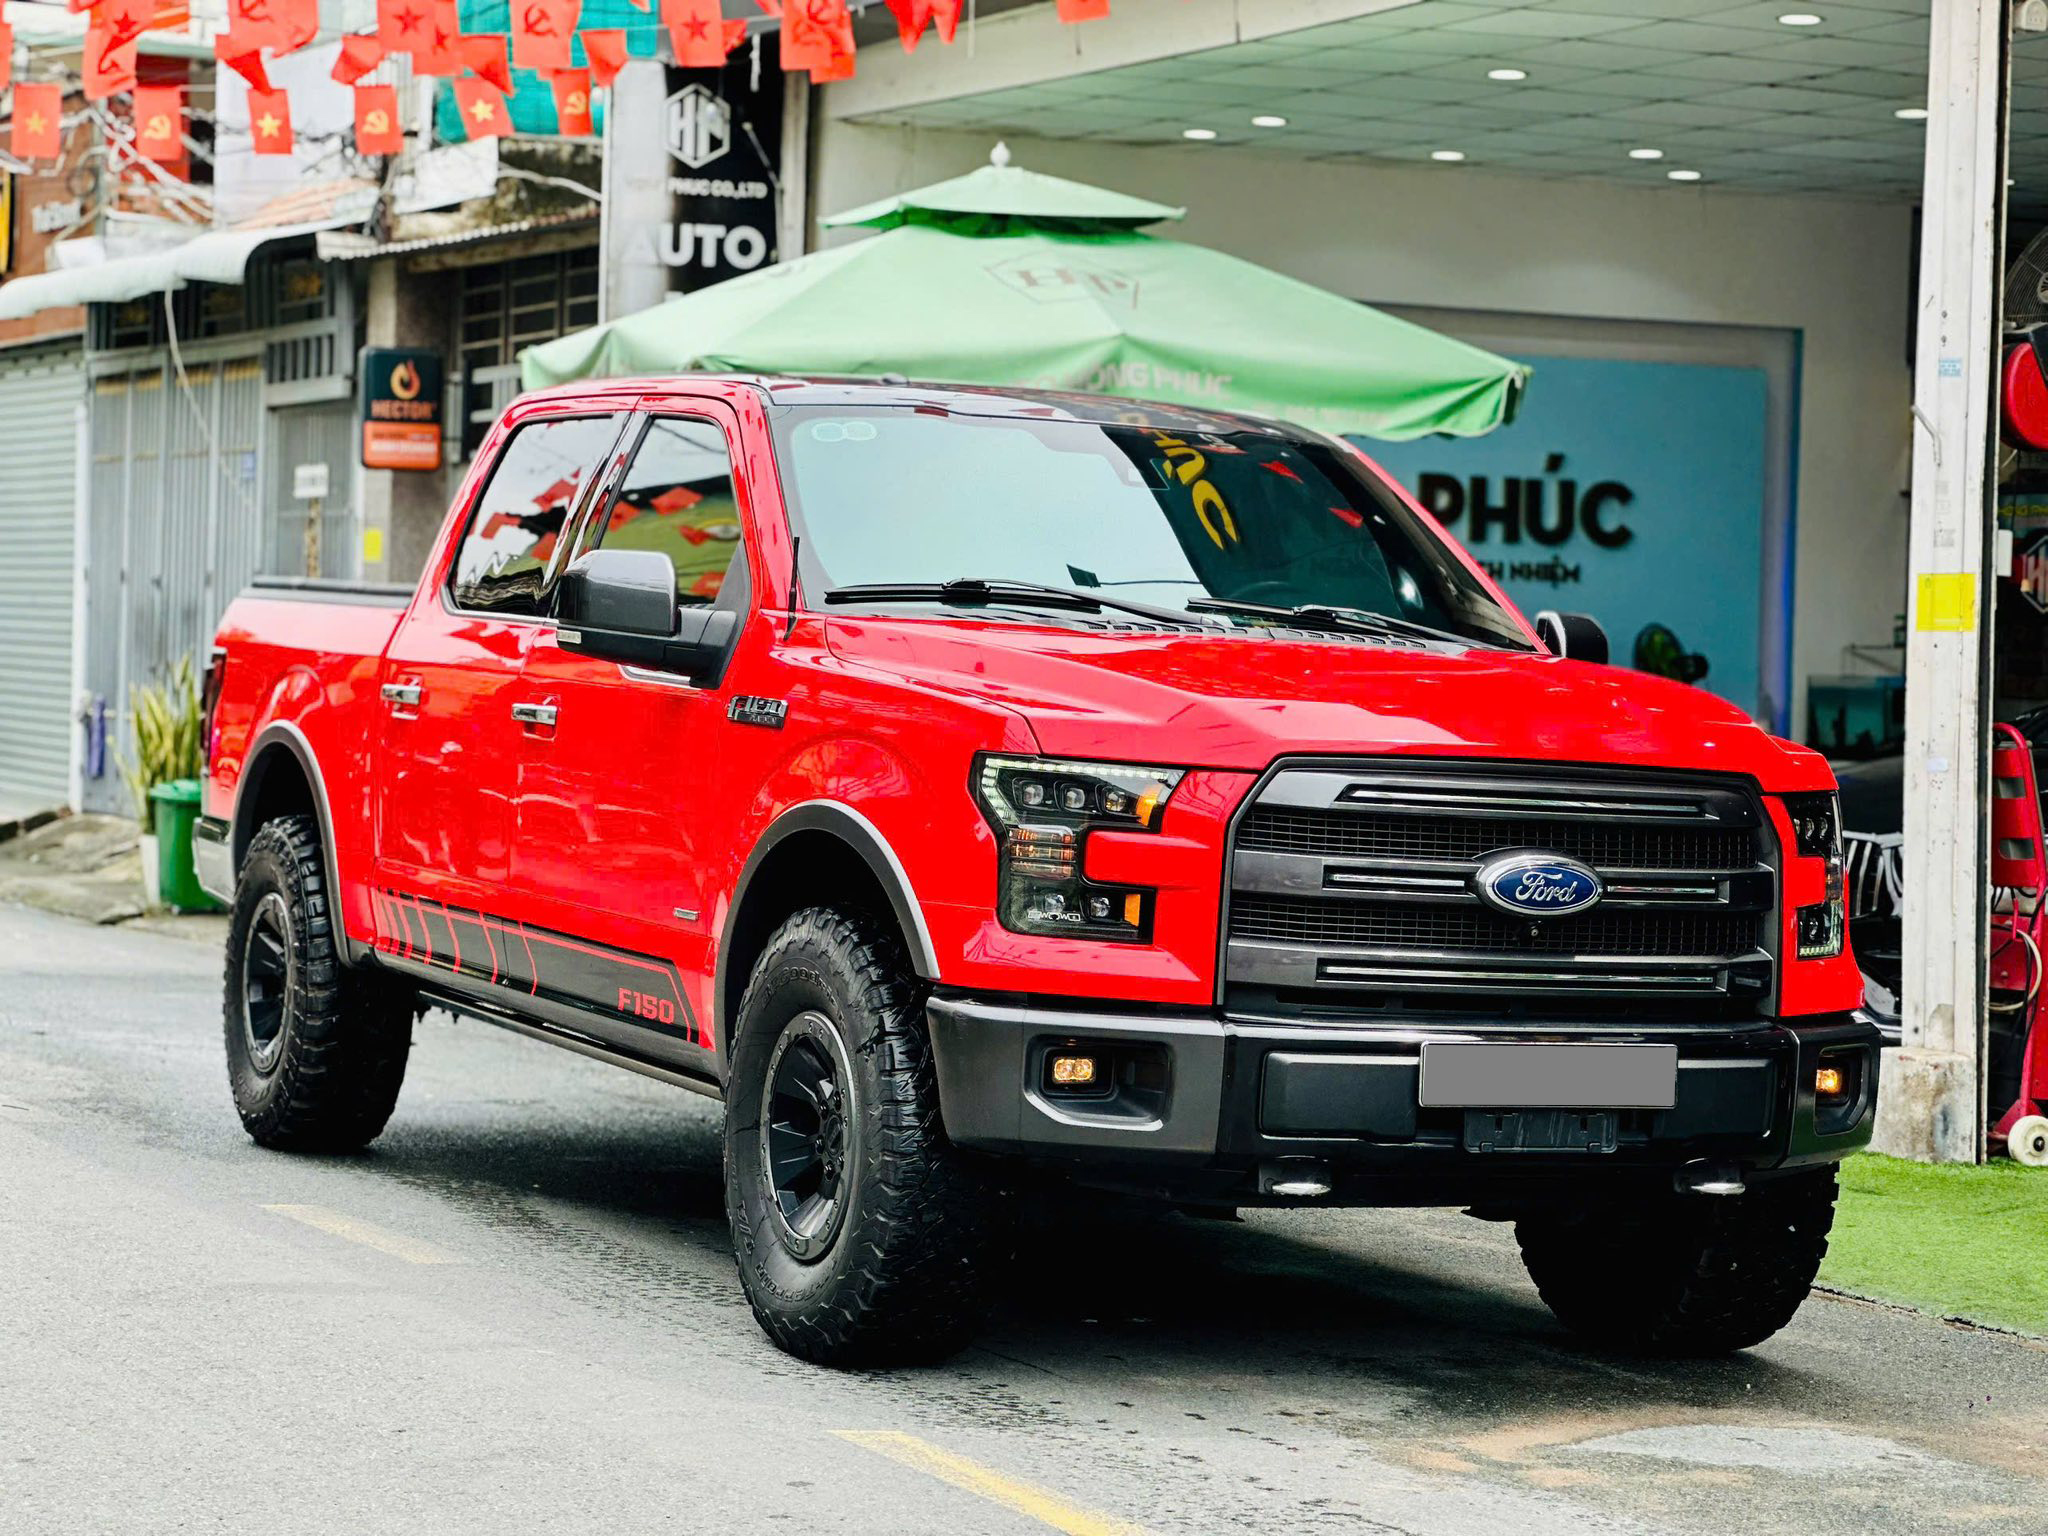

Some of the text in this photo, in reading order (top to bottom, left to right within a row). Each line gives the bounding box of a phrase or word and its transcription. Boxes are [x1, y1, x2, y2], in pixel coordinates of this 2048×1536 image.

[1418, 453, 1634, 547] PHÚC
[1515, 871, 1578, 902] Ford
[618, 987, 675, 1024] F150
